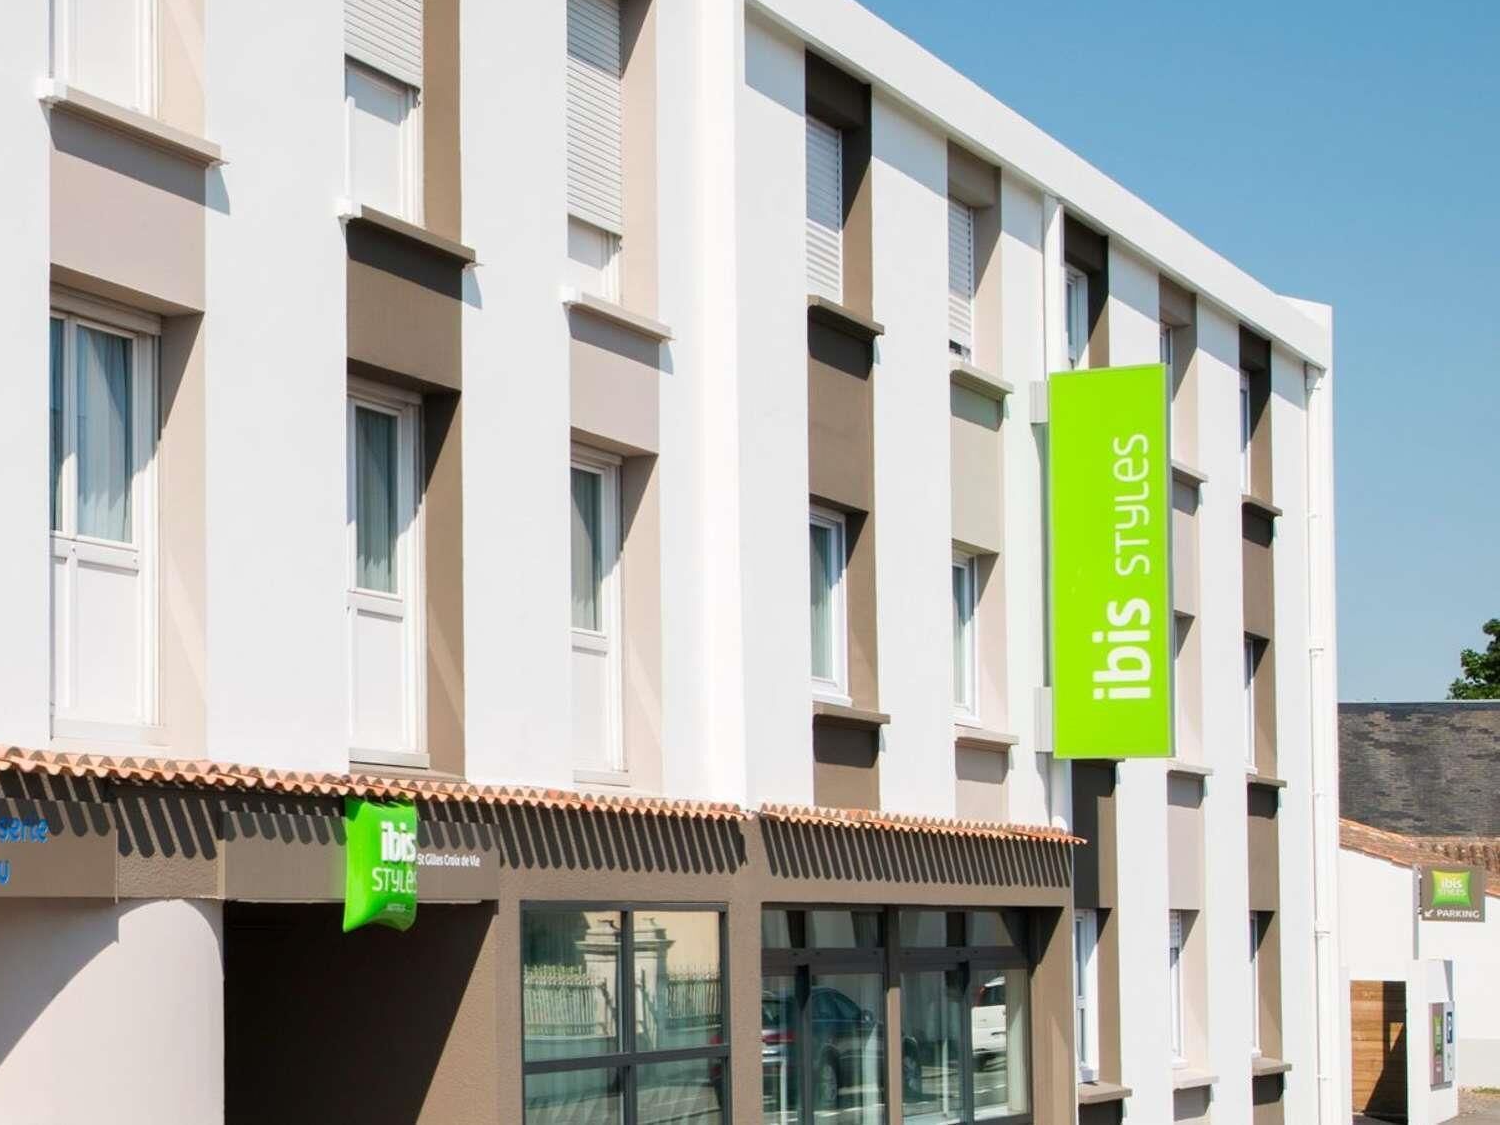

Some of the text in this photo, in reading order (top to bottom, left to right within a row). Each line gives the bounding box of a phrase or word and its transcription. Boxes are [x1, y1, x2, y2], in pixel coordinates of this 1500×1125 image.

[1092, 597, 1152, 700] ibis
[381, 821, 416, 862] ibis
[1437, 909, 1480, 919] PARKING
